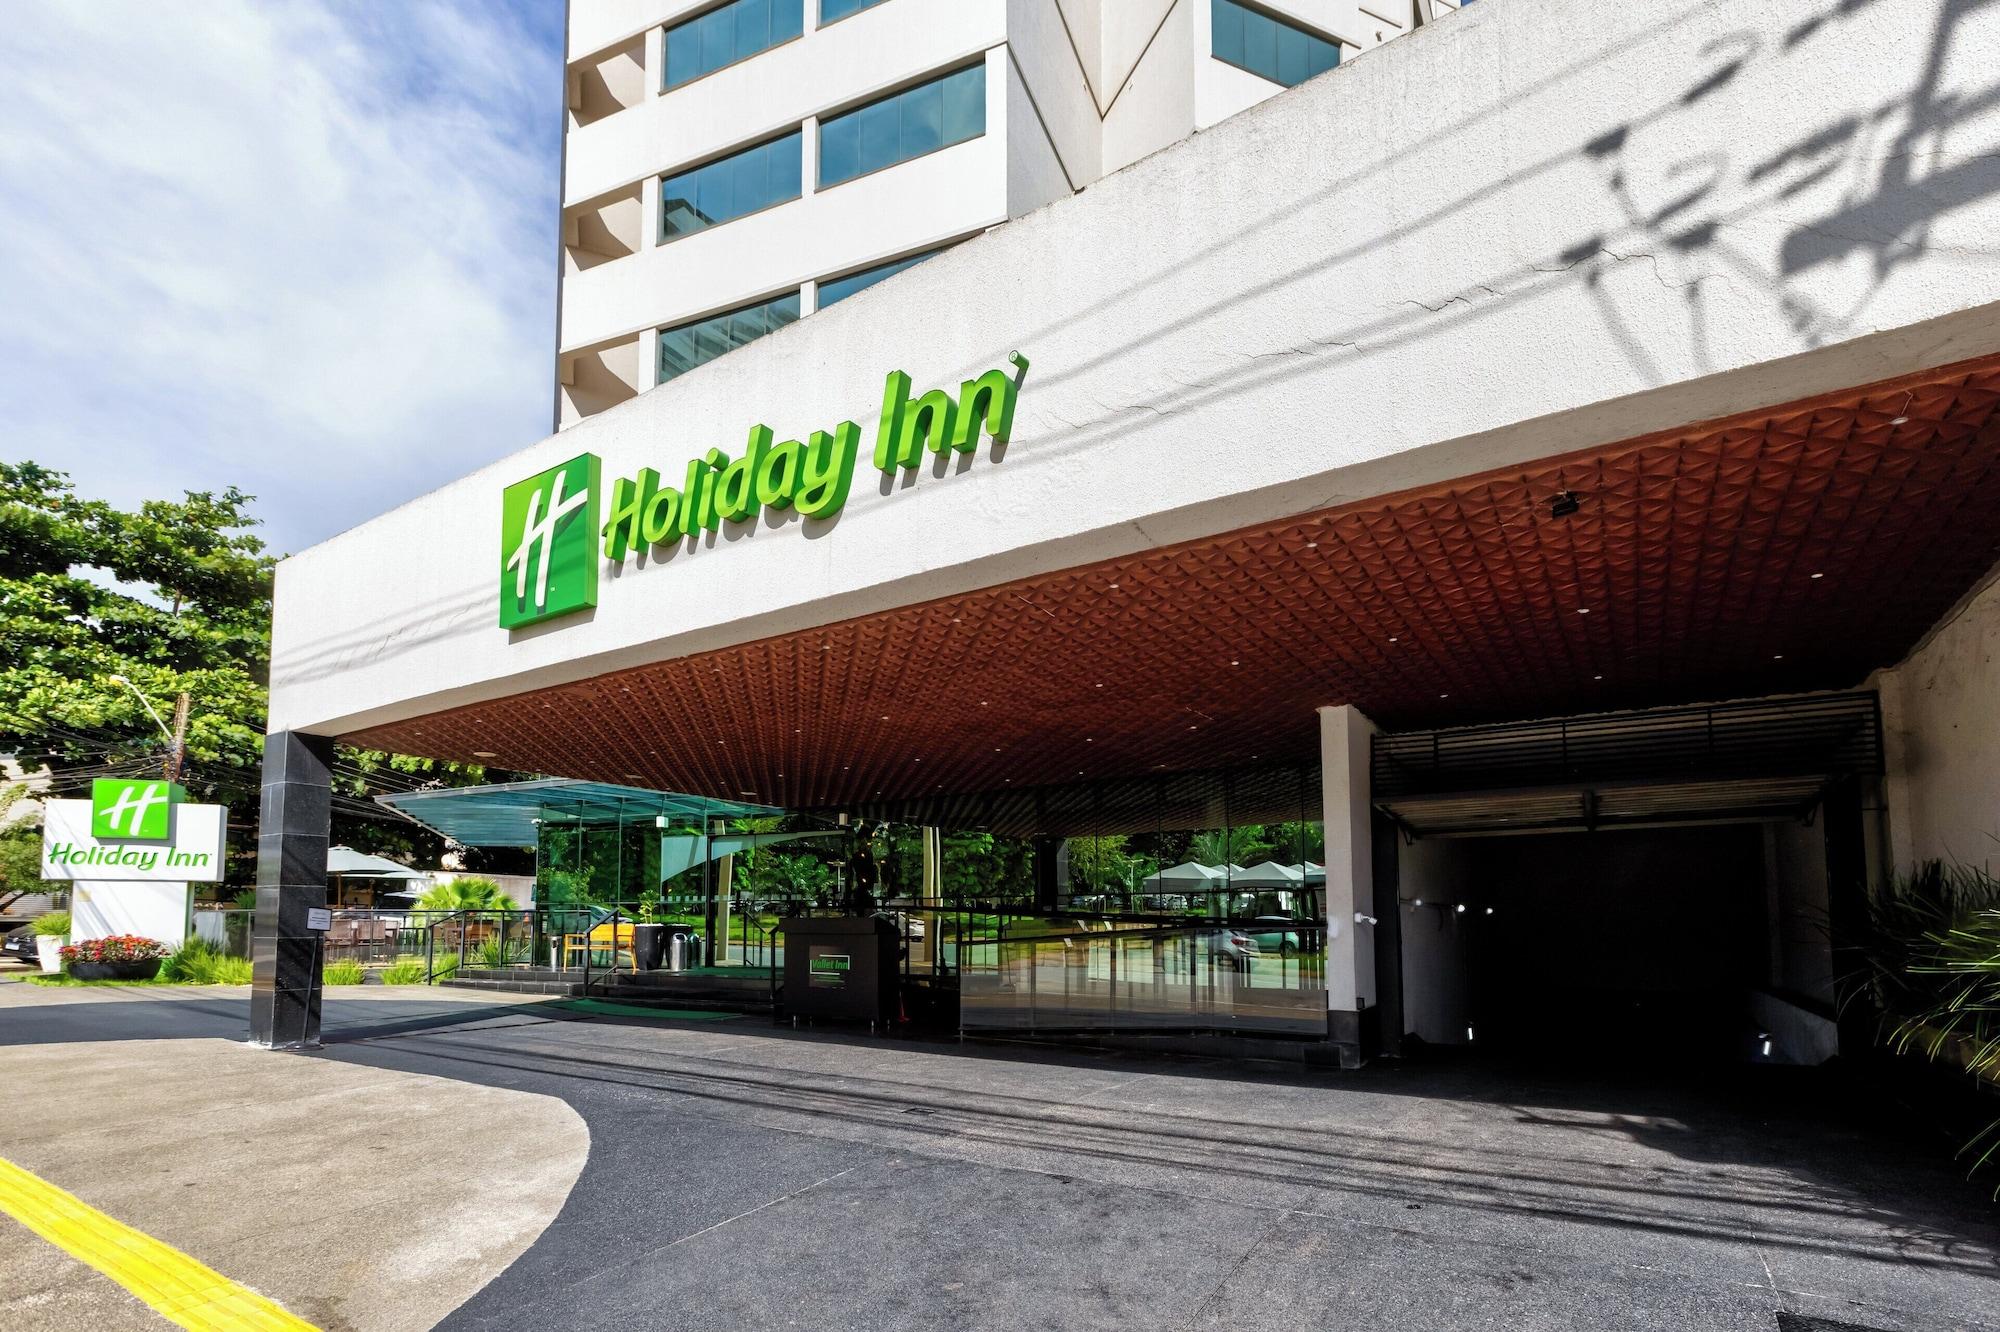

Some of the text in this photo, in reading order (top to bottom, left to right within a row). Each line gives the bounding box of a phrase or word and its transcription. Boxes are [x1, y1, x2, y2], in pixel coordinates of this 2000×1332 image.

[602, 369, 1018, 562] Holiday Inn
[48, 842, 209, 871] Holiday Inn
